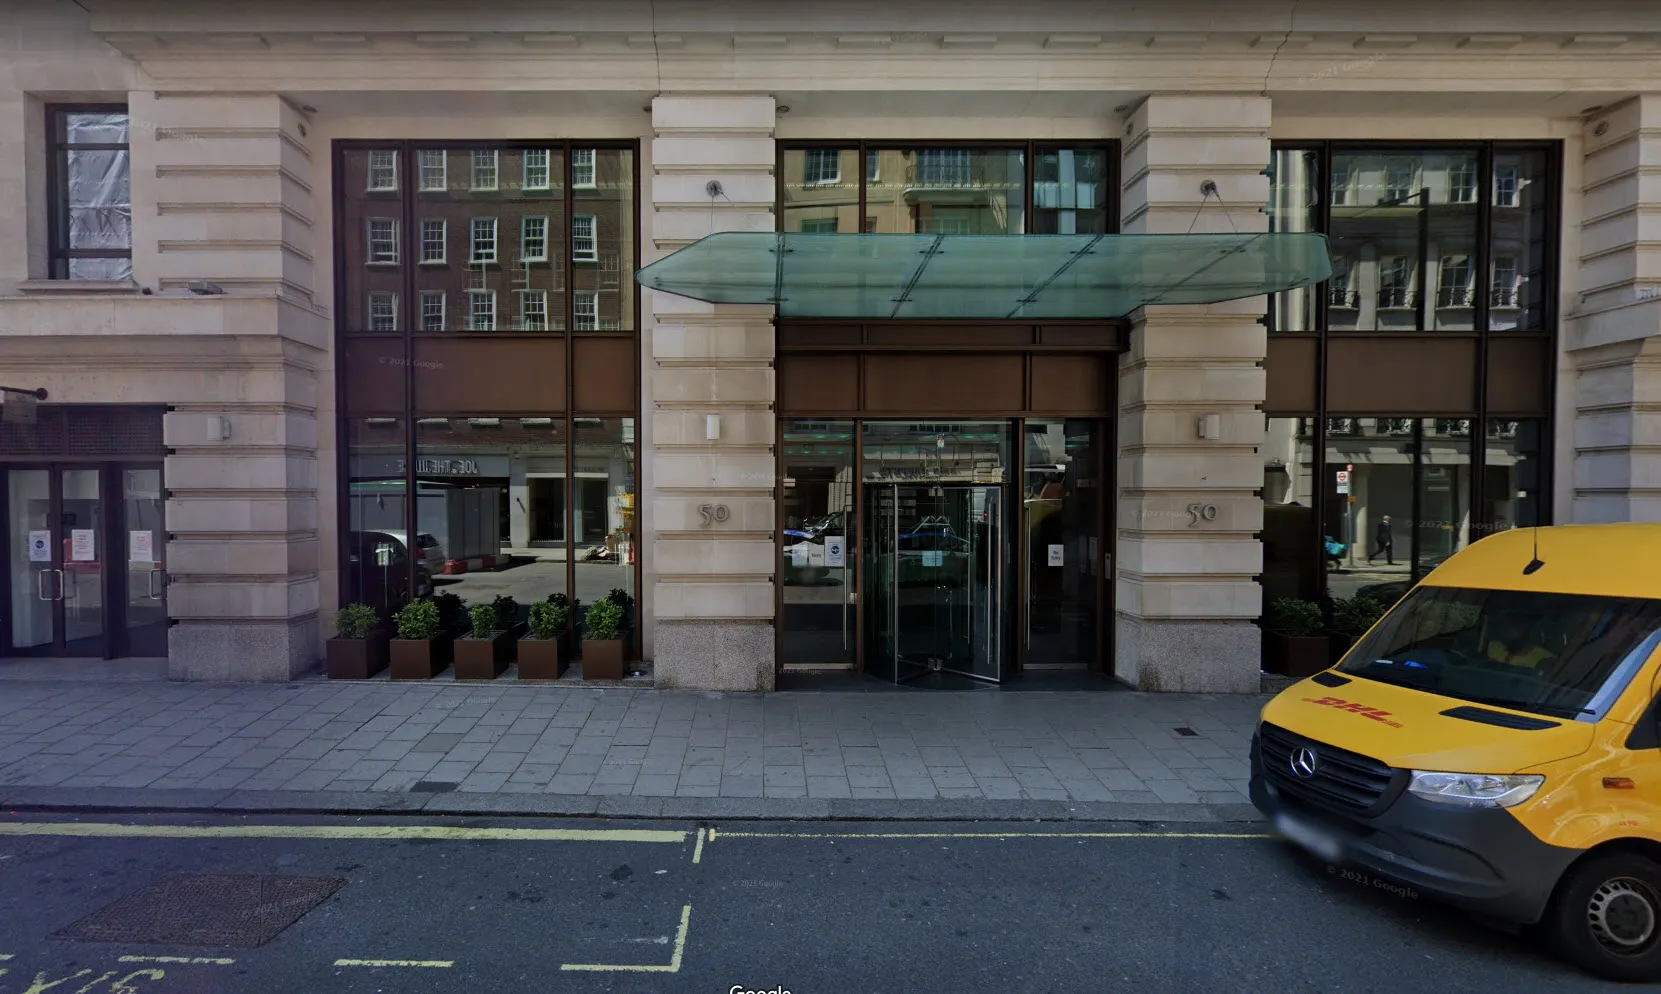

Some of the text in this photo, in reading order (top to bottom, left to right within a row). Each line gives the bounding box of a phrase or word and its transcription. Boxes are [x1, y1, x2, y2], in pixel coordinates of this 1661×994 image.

[698, 503, 730, 528] 50
[1186, 503, 1217, 528] 50
[1310, 697, 1394, 723] DHL
